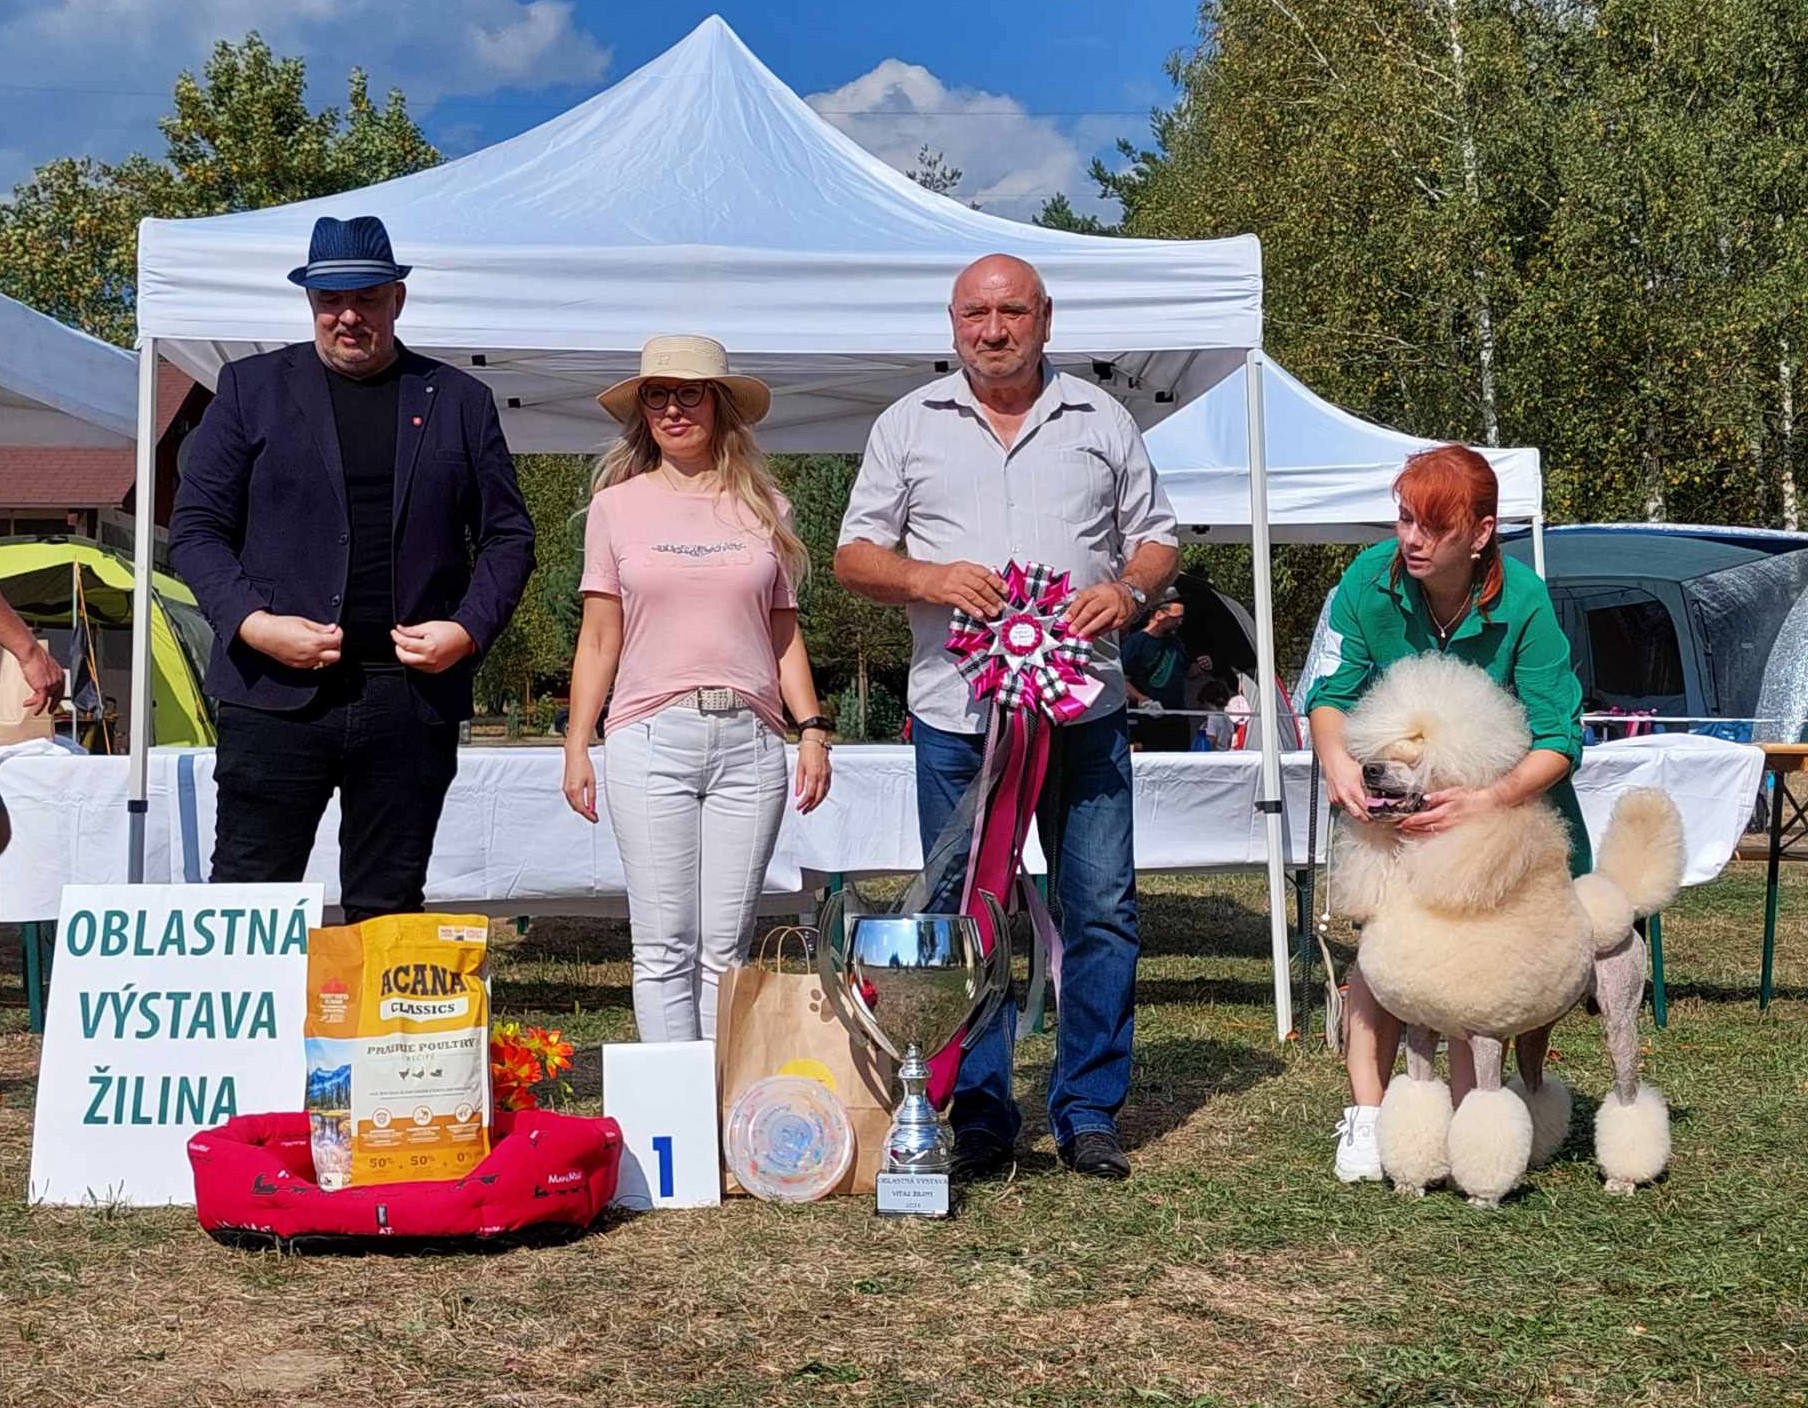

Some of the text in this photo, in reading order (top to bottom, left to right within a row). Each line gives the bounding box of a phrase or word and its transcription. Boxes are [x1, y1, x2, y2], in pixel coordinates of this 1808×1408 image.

[67, 898, 308, 957] OBLASTNÁ
[381, 963, 467, 996] ACANA
[79, 983, 278, 1039] VÝSTAVA
[390, 1002, 455, 1015] CLASSICS
[367, 1037, 475, 1055] PRAIRIE POULTRY
[83, 1065, 238, 1125] ŽILINA
[652, 1136, 674, 1197] 1
